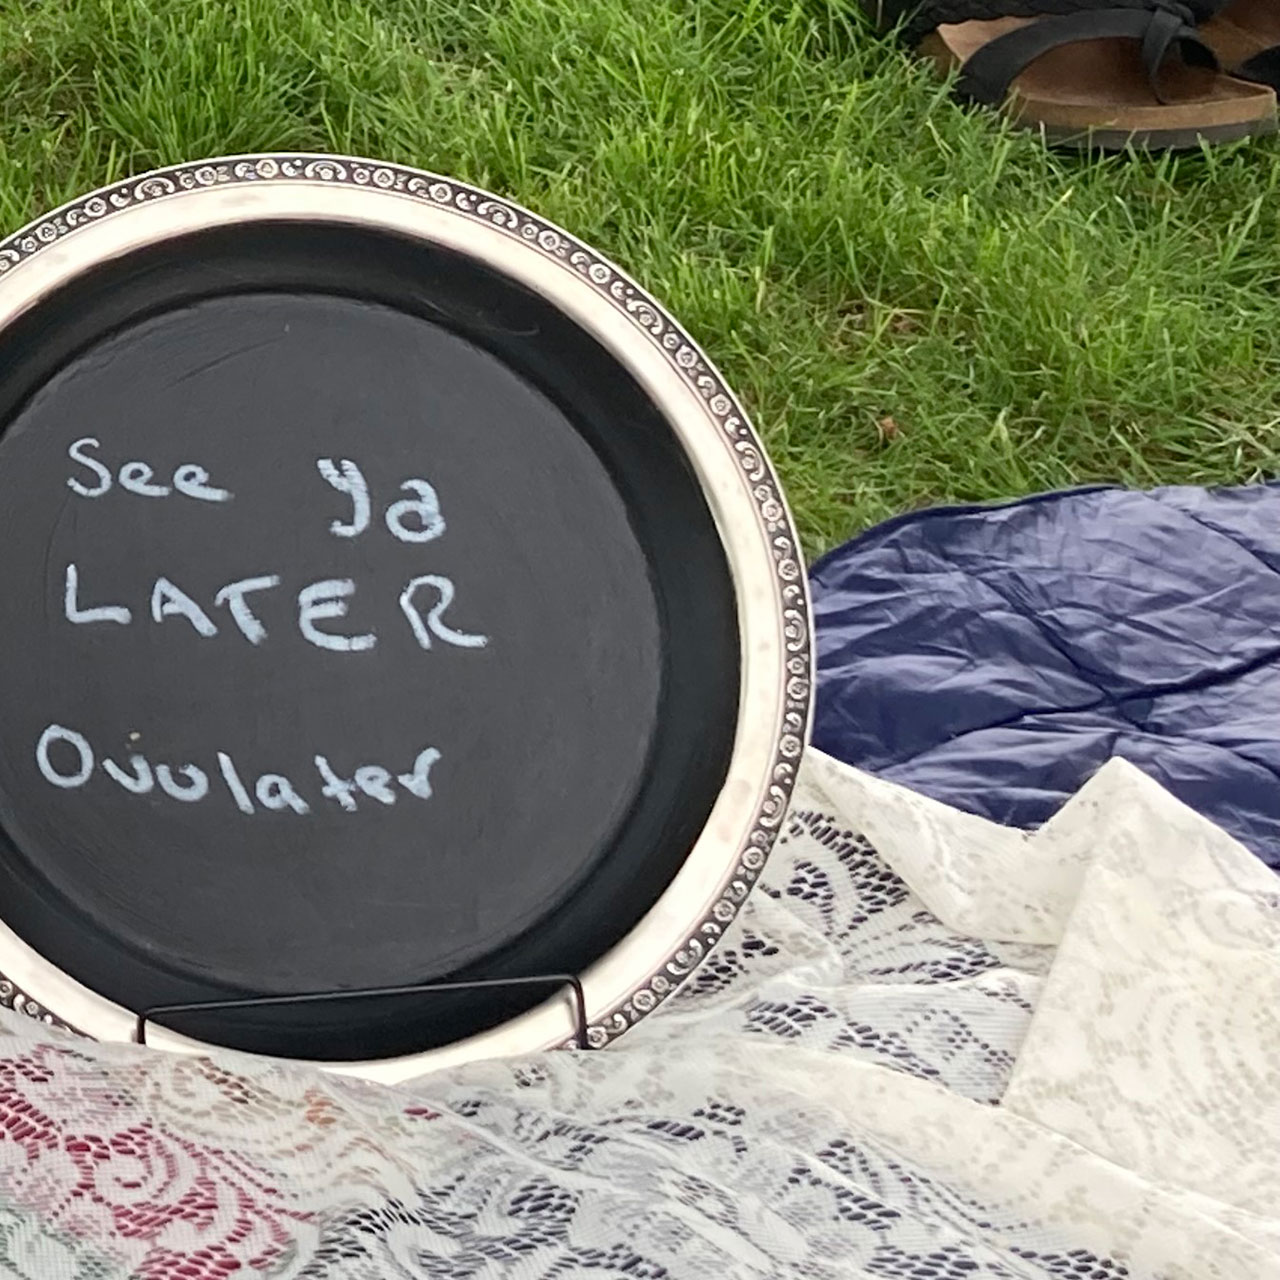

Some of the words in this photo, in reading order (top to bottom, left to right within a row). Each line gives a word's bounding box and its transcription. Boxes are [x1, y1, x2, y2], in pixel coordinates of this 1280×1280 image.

[66, 437, 236, 503] See
[316, 457, 447, 543] ya
[64, 564, 491, 652] LATER
